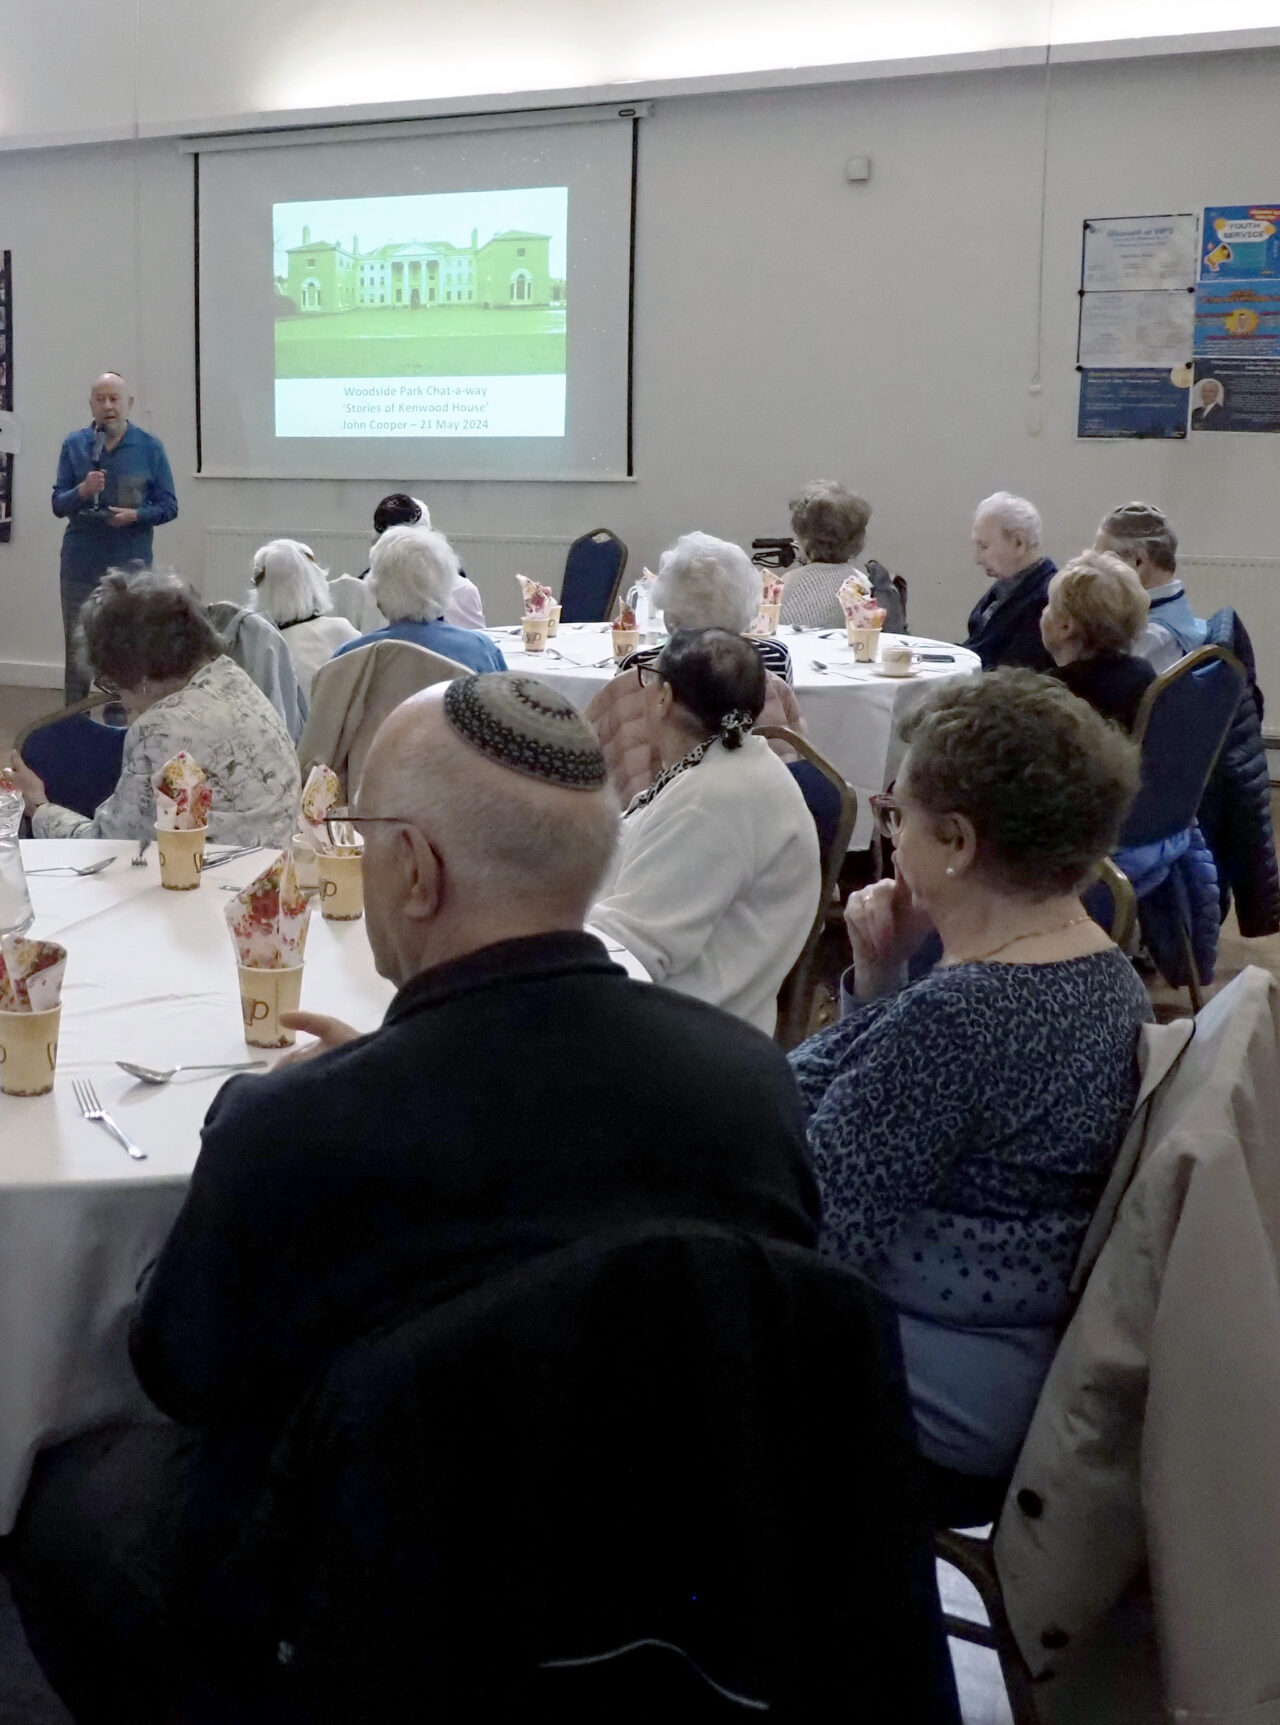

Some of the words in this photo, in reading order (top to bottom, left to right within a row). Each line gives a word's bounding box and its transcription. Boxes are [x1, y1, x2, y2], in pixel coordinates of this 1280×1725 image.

[344, 385, 397, 397] Woodside
[400, 385, 424, 396] Park
[426, 384, 488, 397] Chat-a-way
[384, 402, 395, 413] of
[398, 402, 449, 413] Kenwood
[342, 419, 366, 430] John
[369, 419, 407, 432] Cooper
[420, 419, 432, 430] 21
[436, 419, 460, 432] May
[462, 419, 489, 430] 2024
